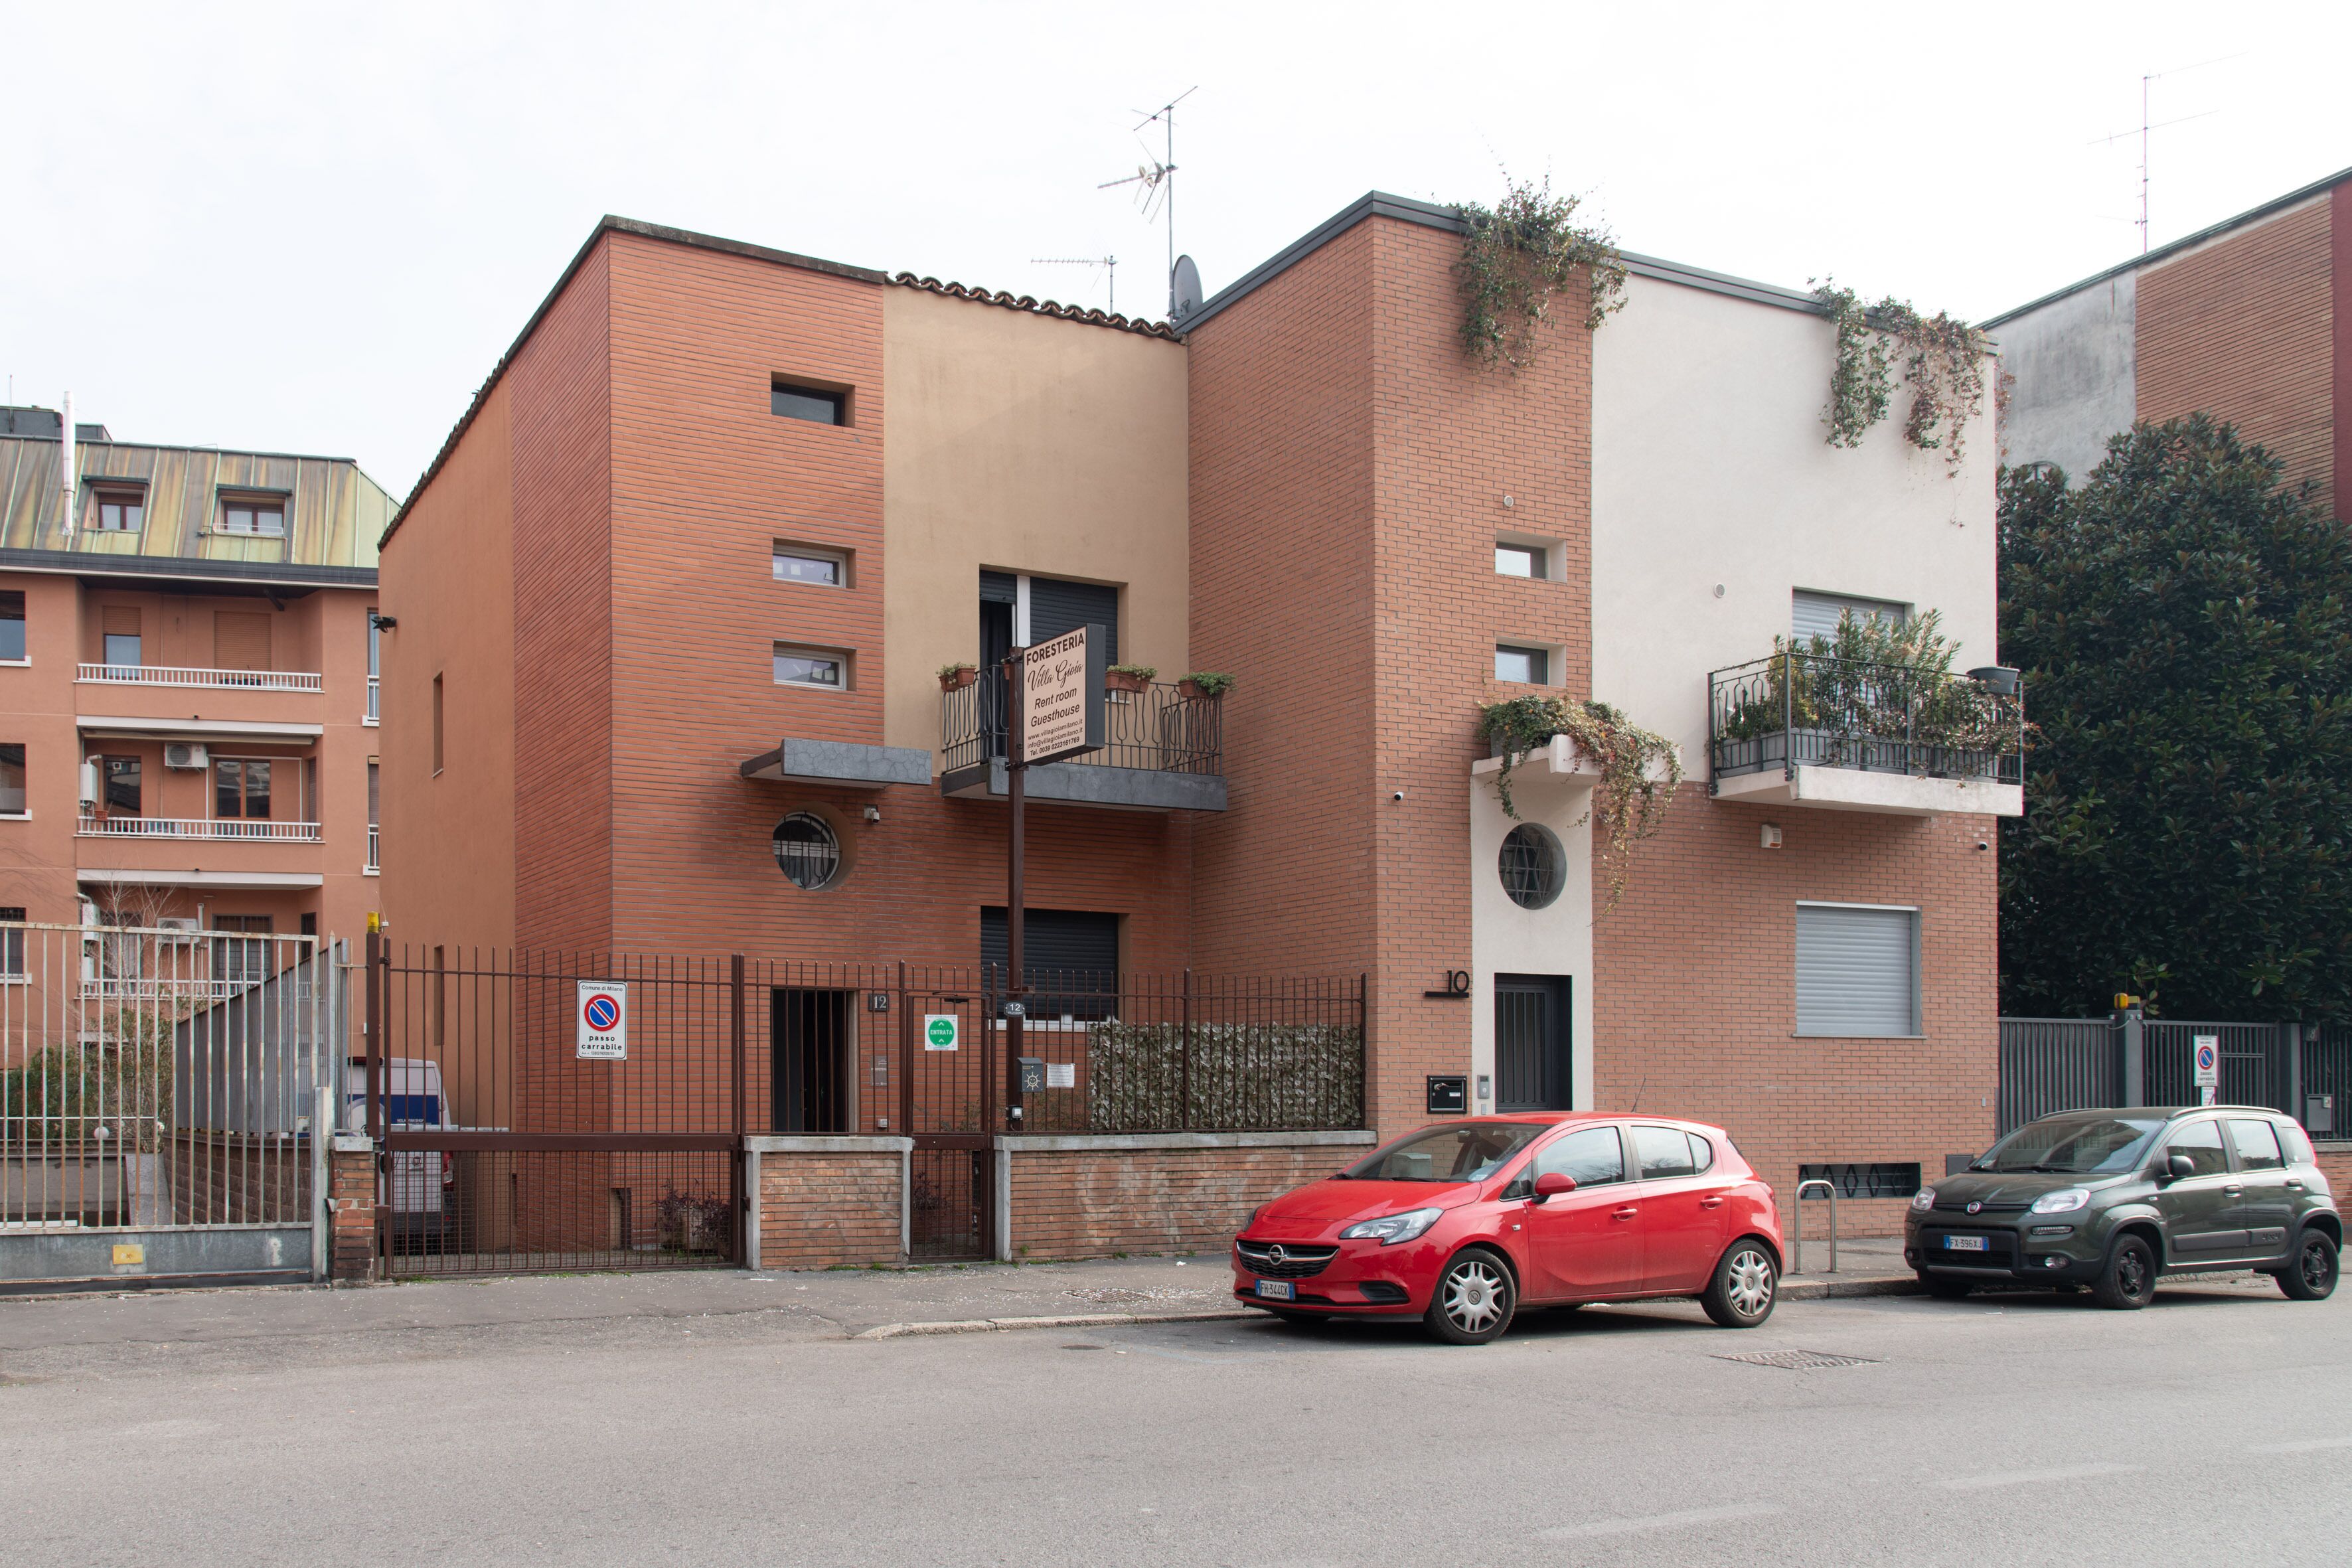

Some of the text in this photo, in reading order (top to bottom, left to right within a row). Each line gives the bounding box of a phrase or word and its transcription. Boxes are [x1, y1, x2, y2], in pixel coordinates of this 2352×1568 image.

[1026, 633, 1084, 666] FORESTERIA
[1028, 659, 1083, 691] Villa Gioia
[1034, 688, 1077, 710] Rent room
[1031, 704, 1079, 727] Guesthouse
[1027, 728, 1083, 749] info@villagioiamilano.it
[1028, 719, 1083, 740] www.villagioiamilano.it
[1039, 745, 1050, 754] 0039
[1447, 970, 1470, 993] 10
[874, 995, 887, 1009] 12
